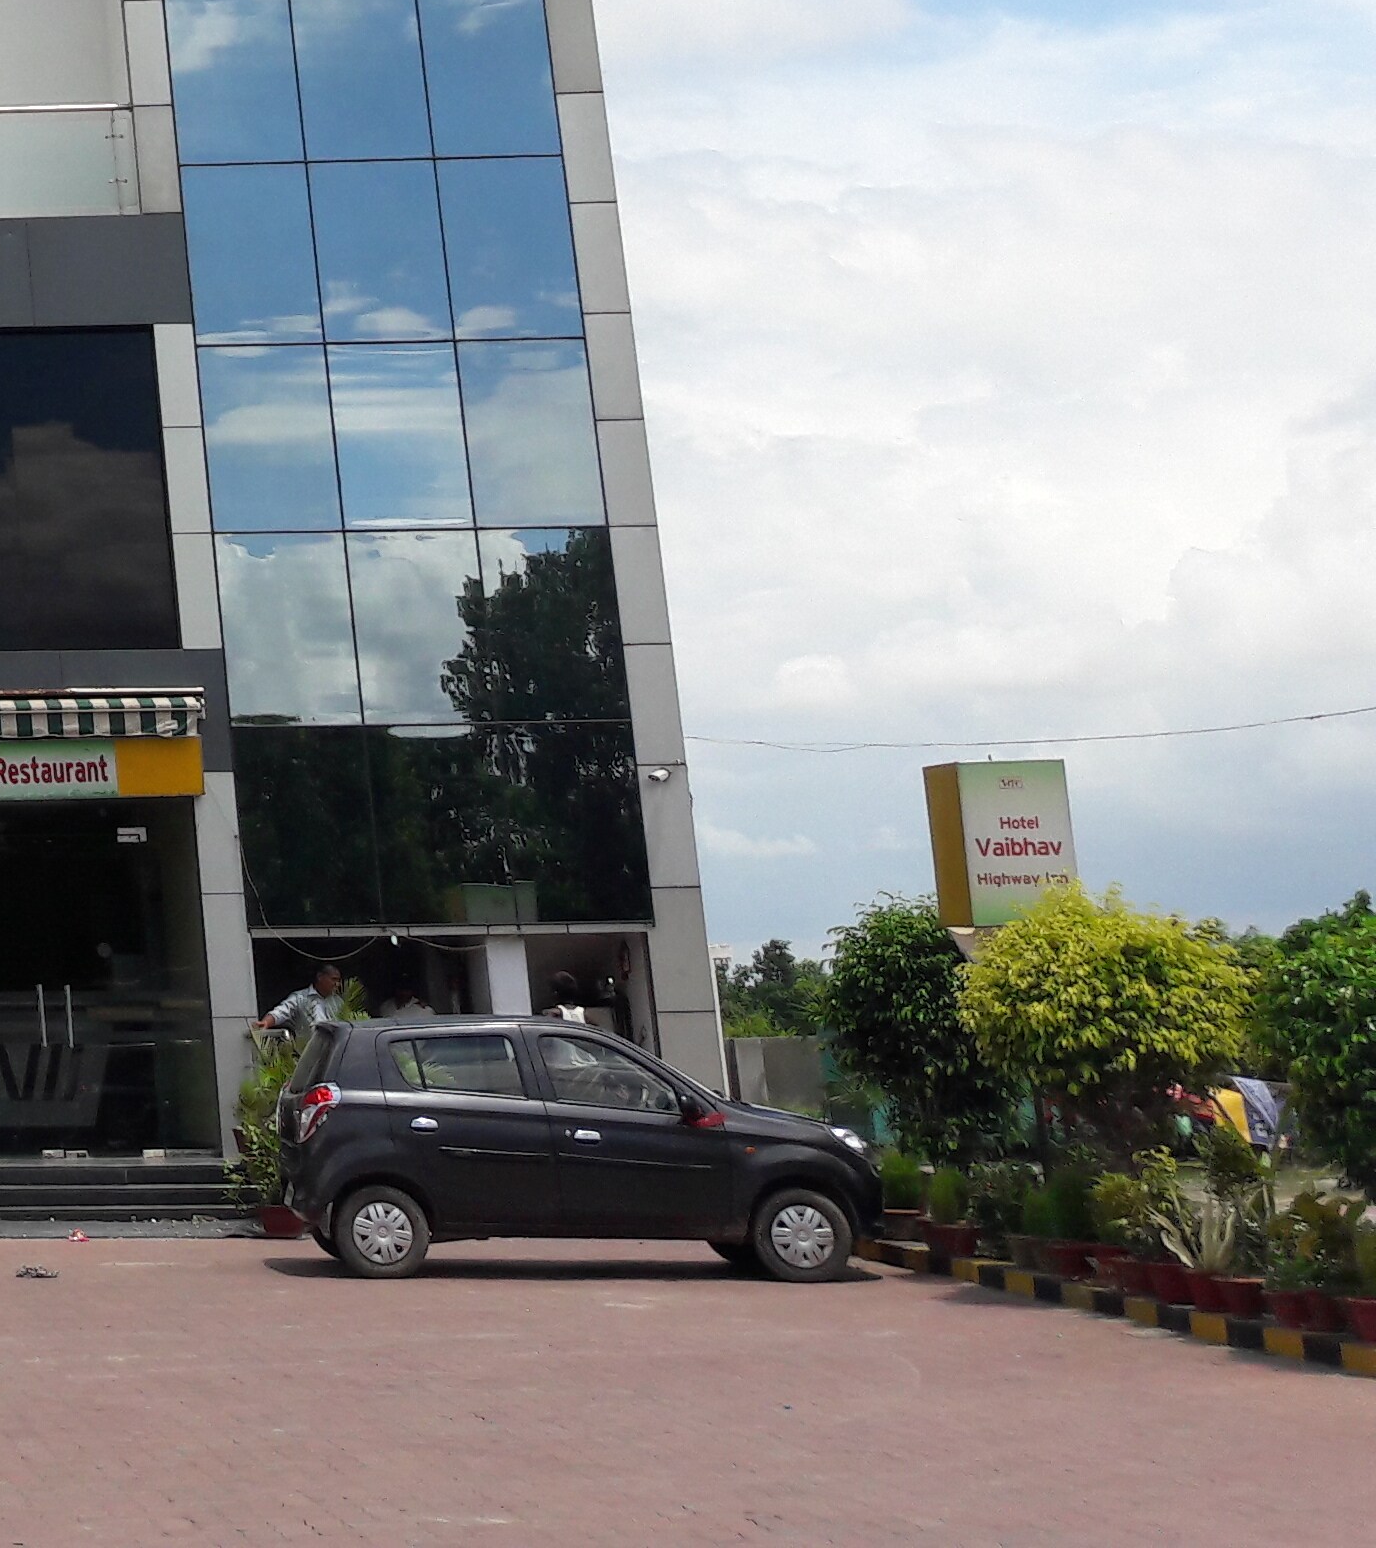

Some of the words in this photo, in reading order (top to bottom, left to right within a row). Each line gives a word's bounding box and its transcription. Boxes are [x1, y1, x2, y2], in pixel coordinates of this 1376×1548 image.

[999, 816, 1040, 830] Hotel
[975, 837, 1062, 857] Vaibhav
[977, 872, 1041, 888] Highway
